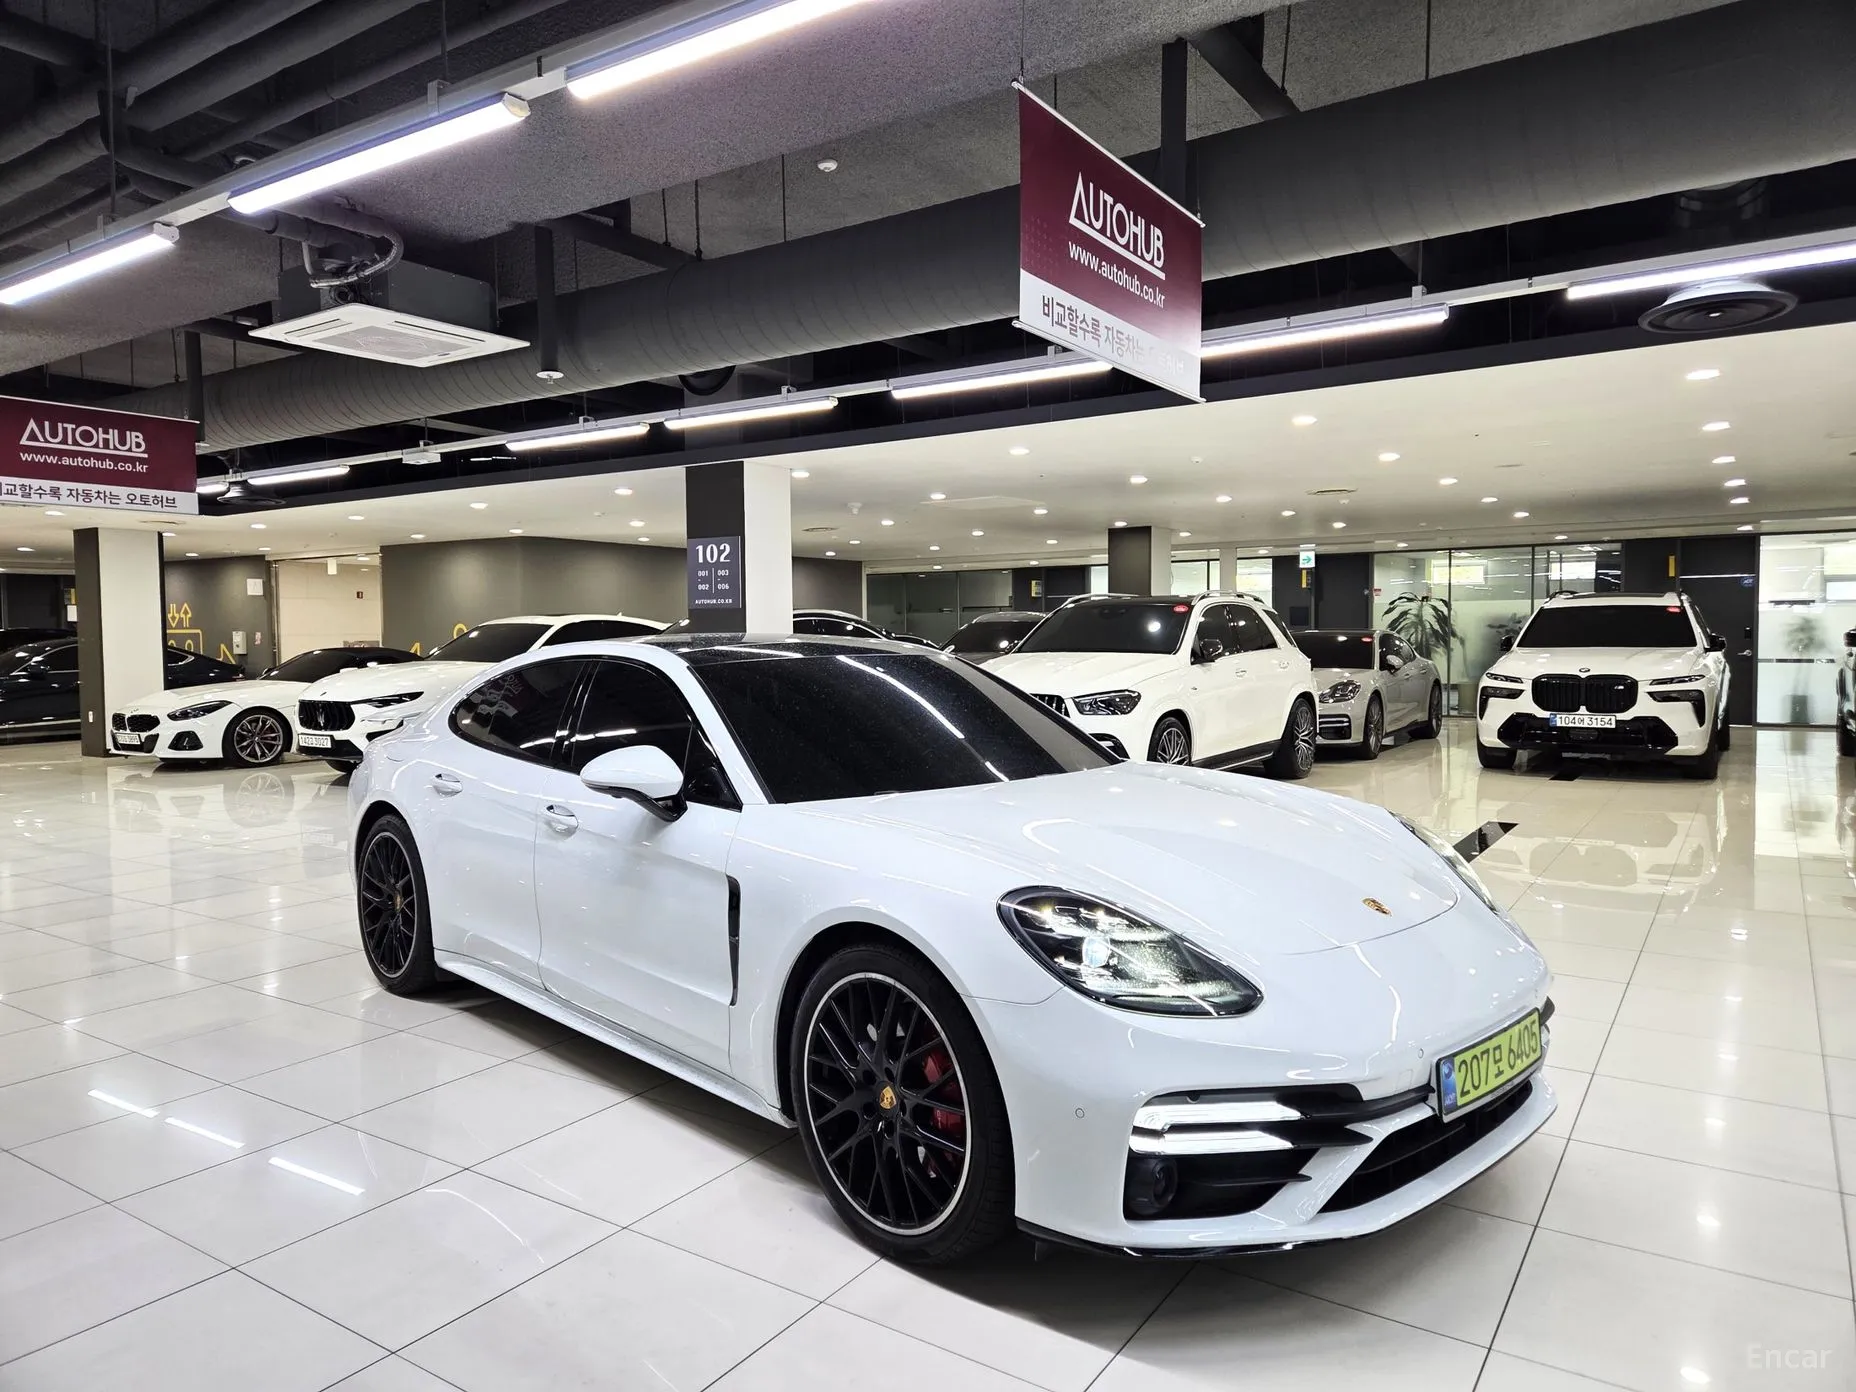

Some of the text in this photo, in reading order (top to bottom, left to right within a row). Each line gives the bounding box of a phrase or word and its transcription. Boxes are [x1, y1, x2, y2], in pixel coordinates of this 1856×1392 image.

[1069, 171, 1165, 280] AUTOHUB
[1069, 241, 1165, 309] www.autohub.co.kr
[1042, 295, 1102, 348] 비교할수록
[19, 418, 148, 457] AUTOHUB
[19, 452, 148, 473] www.autohub.co.kr
[66, 488, 121, 505] 자동차는
[125, 493, 178, 509] 오토허브
[695, 543, 731, 563] 102
[1587, 717, 1613, 726] 3154
[1458, 1020, 1539, 1098] 207모 6405
